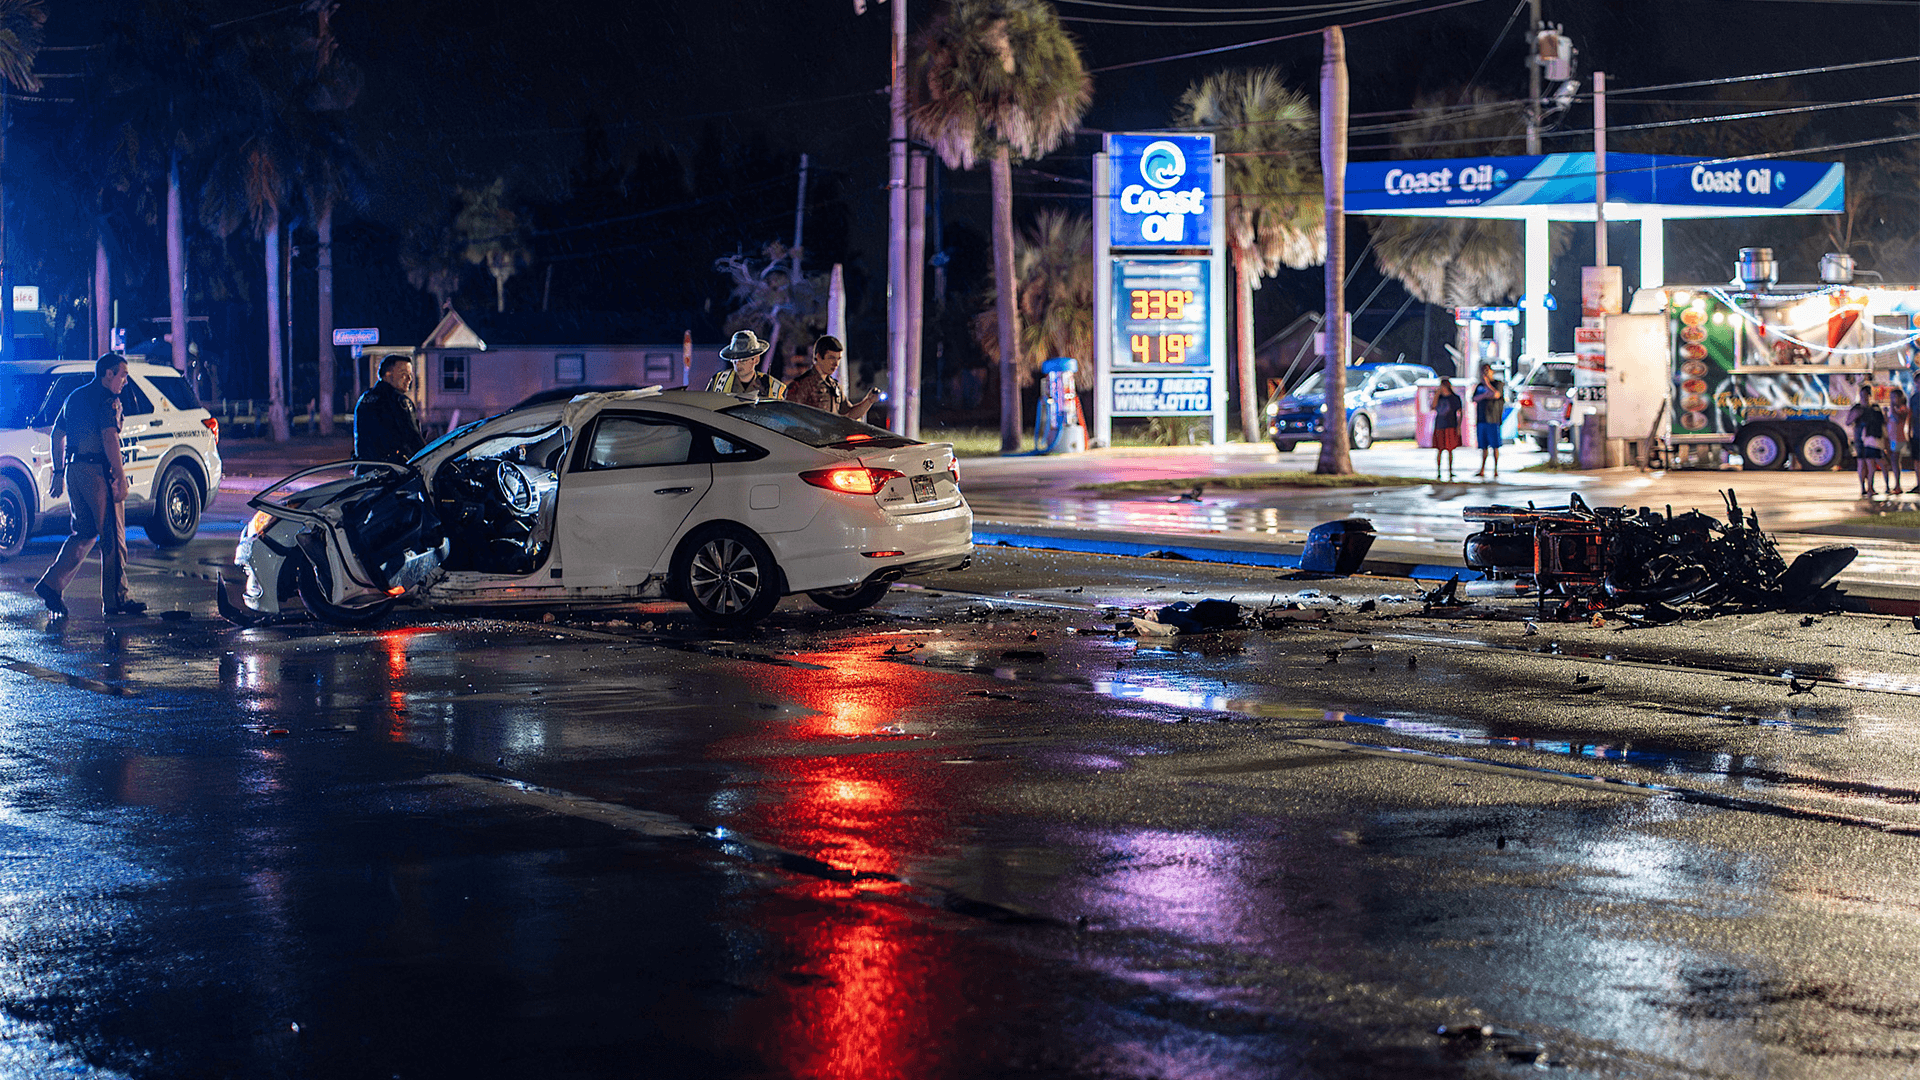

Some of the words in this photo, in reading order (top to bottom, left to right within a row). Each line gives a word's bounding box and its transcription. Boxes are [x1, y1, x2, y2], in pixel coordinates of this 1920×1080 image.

[1385, 168, 1453, 196] Coast
[1459, 165, 1493, 192] Oil
[1691, 165, 1742, 193] Coast
[1746, 168, 1771, 194] Oil
[1120, 184, 1205, 214] Coast
[1141, 213, 1184, 241] Oil
[1114, 379, 1159, 393] COLD
[1162, 379, 1208, 393] BEER
